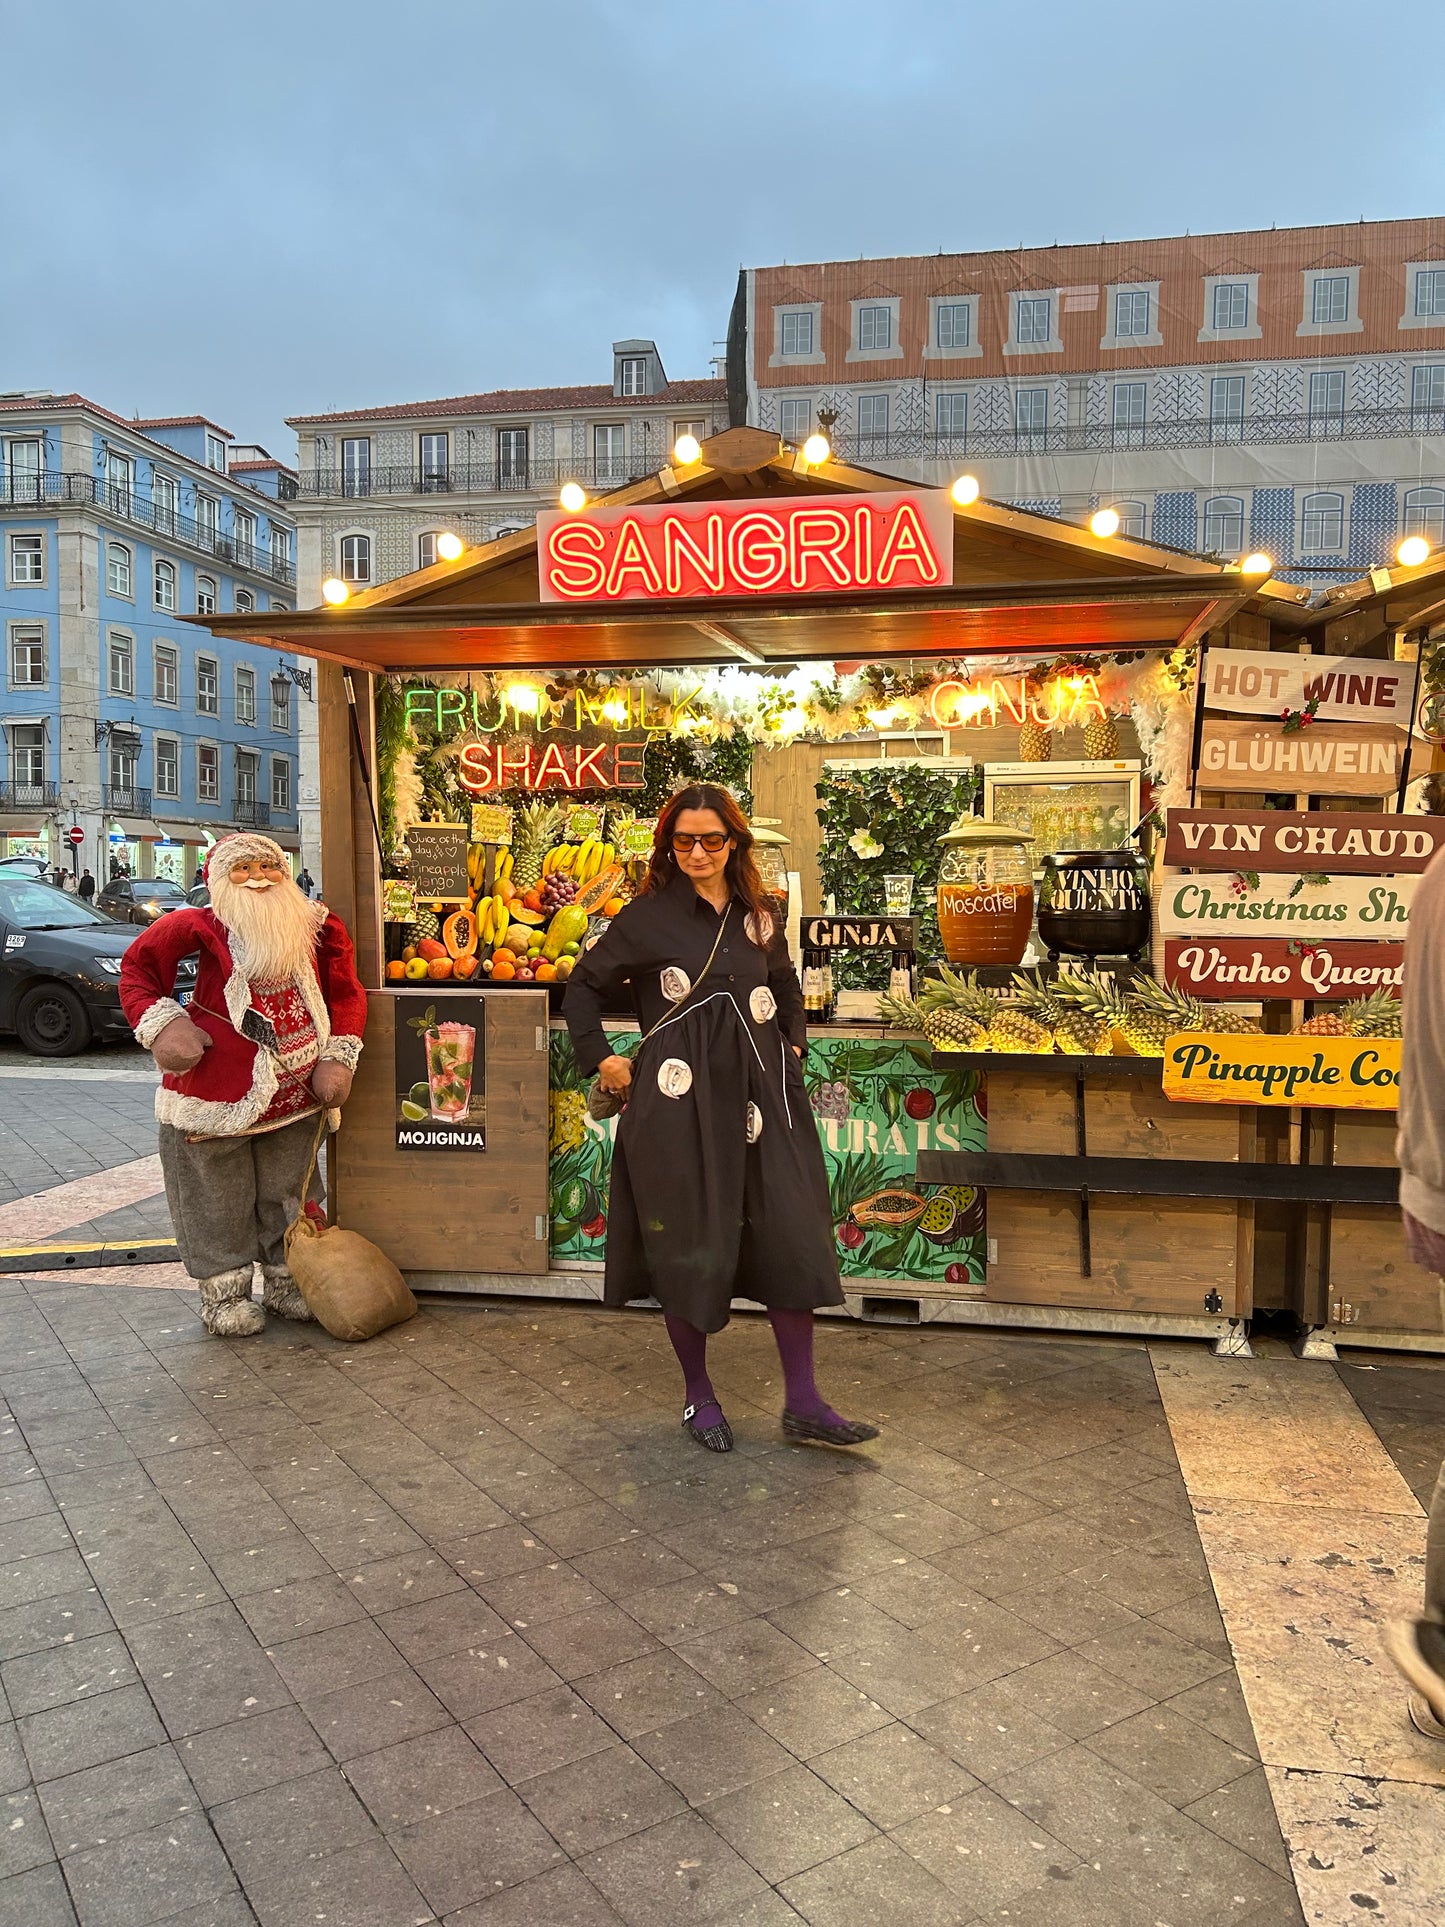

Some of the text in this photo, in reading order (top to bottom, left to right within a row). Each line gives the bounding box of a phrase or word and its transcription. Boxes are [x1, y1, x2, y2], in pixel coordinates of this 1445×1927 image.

[549, 505, 938, 597] SANGRIA
[1212, 664, 1399, 707] HOT WINE
[404, 686, 704, 732] FRUIT MILK
[459, 742, 646, 789] SHAKE
[1203, 732, 1398, 774] GLÜHWEIN
[409, 832, 466, 845] Juice of the
[415, 844, 432, 857] day
[1178, 822, 1434, 858] VIN CHAUD
[411, 860, 468, 877] Pineapple
[411, 876, 455, 890] Mango
[1057, 869, 1133, 890] VINHO
[943, 886, 1017, 917] Moscatel
[1051, 889, 1143, 910] QUENTE
[1172, 884, 1348, 923] Christmas
[8, 935, 25, 943] 3269
[808, 919, 898, 947] GINJA
[1177, 946, 1292, 984] Vinho
[1172, 1044, 1341, 1097] Pinapple
[398, 1131, 484, 1146] MOJIGINJA
